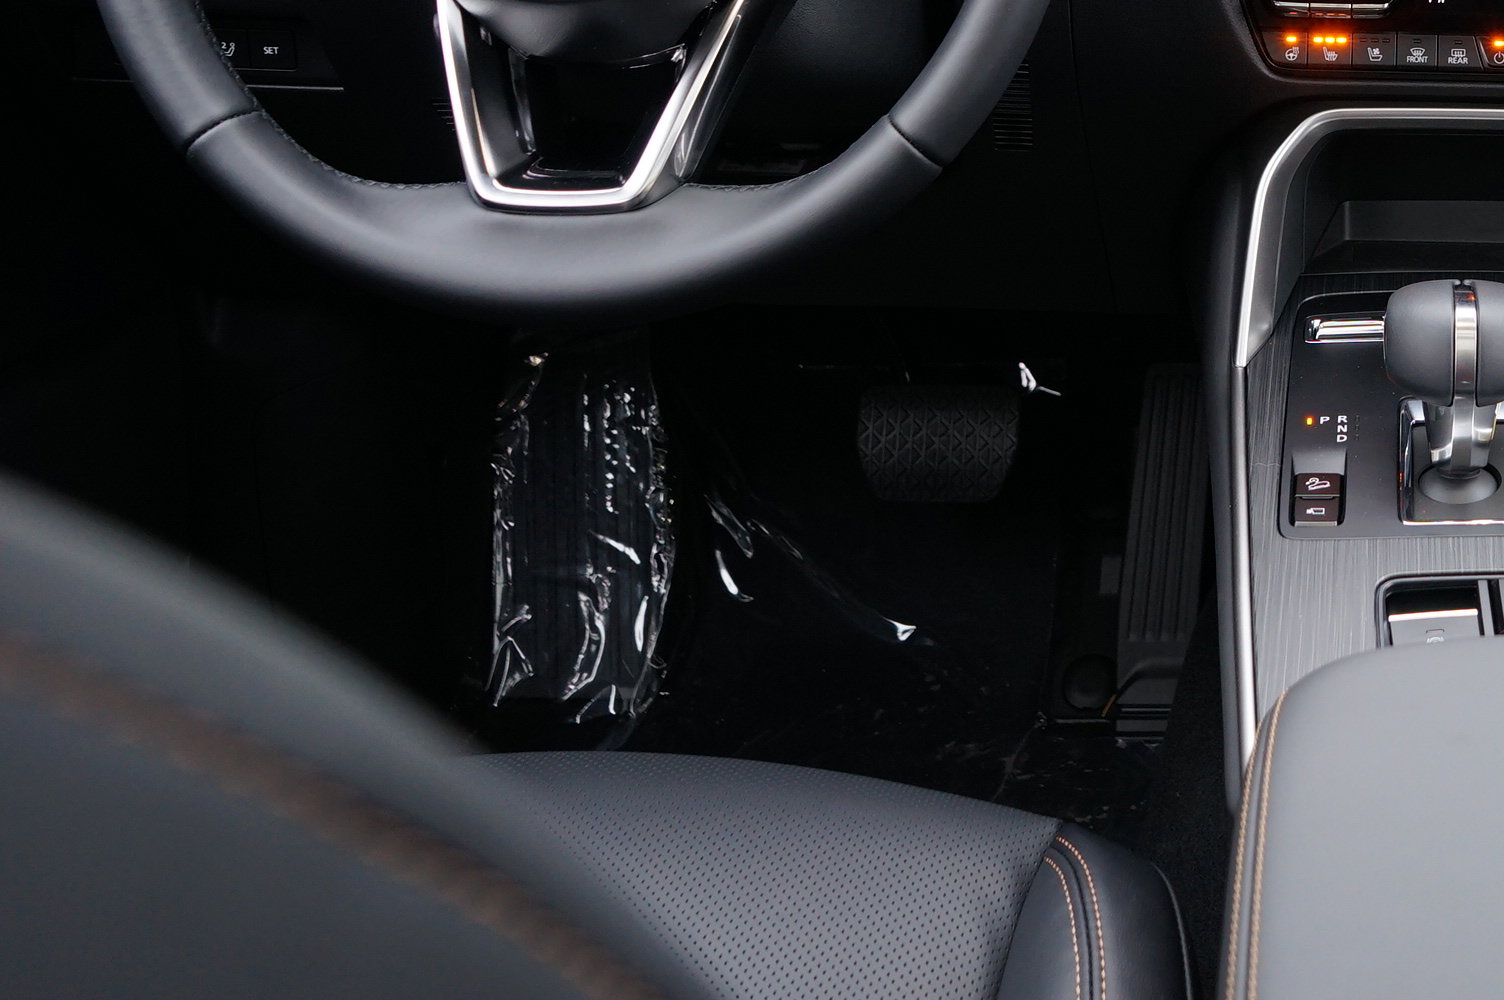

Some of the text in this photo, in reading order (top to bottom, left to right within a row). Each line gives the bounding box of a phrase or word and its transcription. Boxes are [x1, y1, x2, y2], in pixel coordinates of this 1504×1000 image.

[263, 46, 279, 55] SET
[1448, 56, 1468, 64] REAR
[1320, 415, 1347, 424] P R
[1337, 424, 1347, 433] N
[1336, 434, 1347, 442] D
